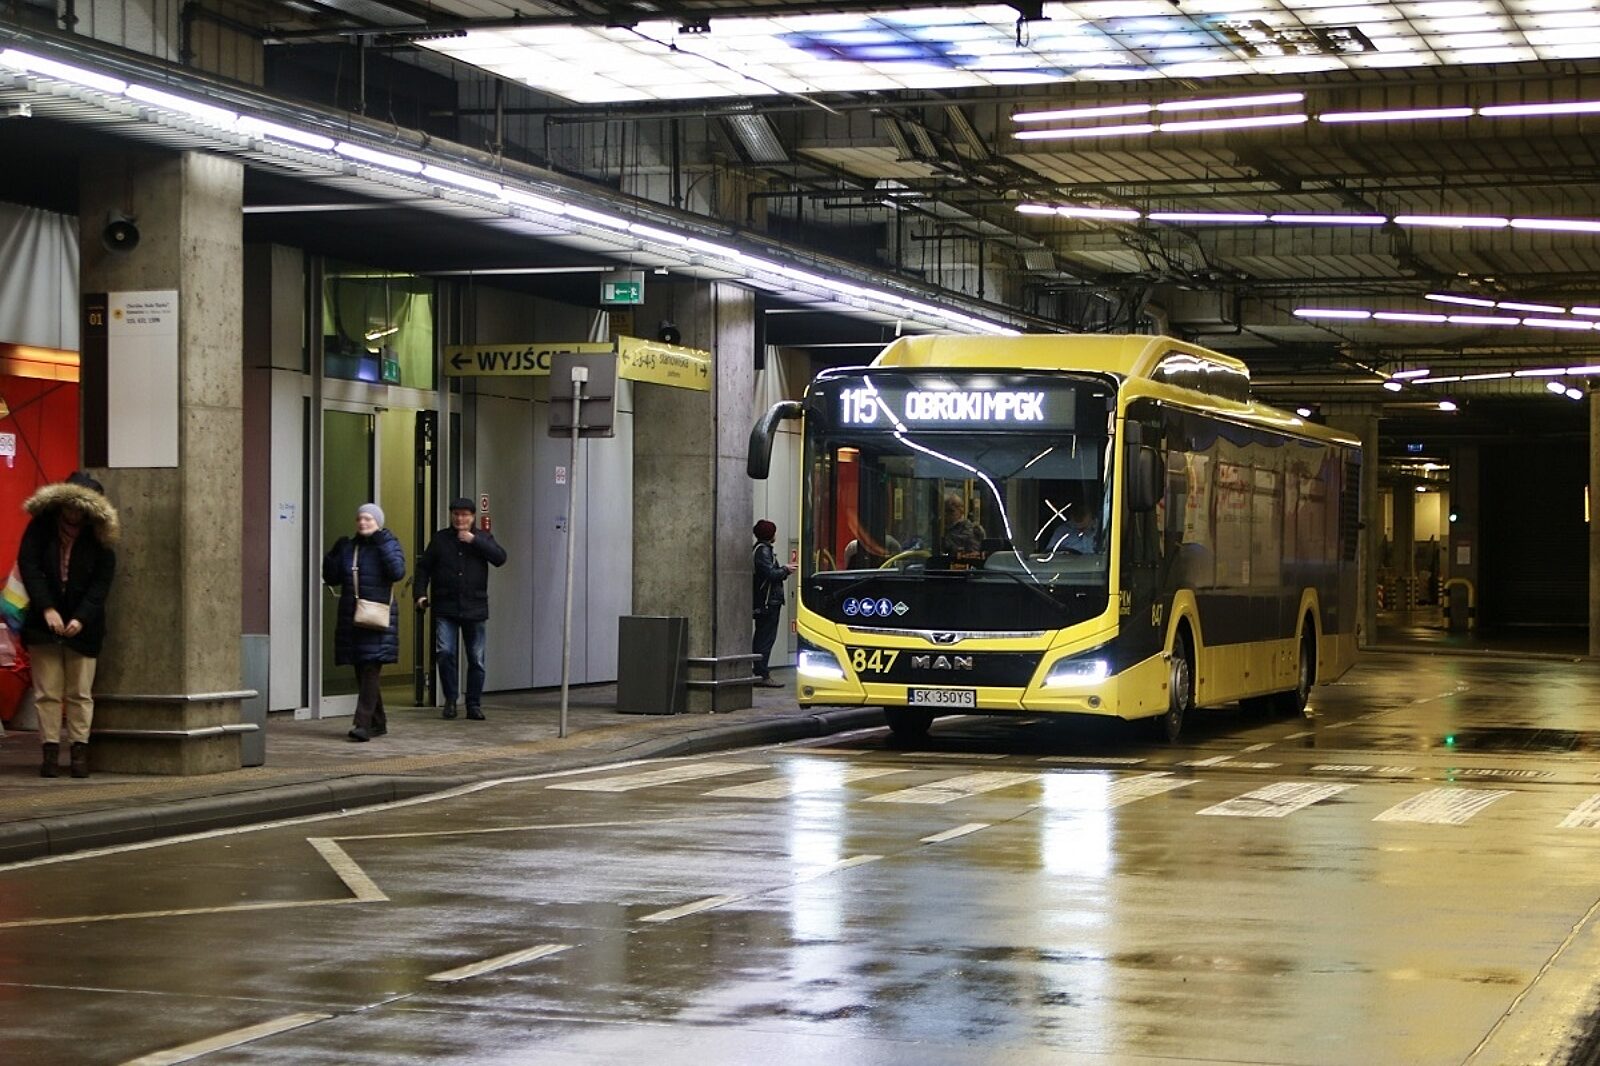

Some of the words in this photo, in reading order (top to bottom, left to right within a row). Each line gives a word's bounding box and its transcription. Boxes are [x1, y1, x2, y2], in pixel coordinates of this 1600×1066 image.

[476, 347, 571, 371] WYJŚC
[839, 388, 878, 424] 115
[904, 391, 981, 421] OBROKI
[983, 391, 1045, 421] MPGK
[1151, 603, 1163, 627] 847
[852, 648, 900, 674] 847
[911, 654, 974, 671] MAN
[916, 690, 932, 703] SK
[935, 691, 973, 705] 350YS
